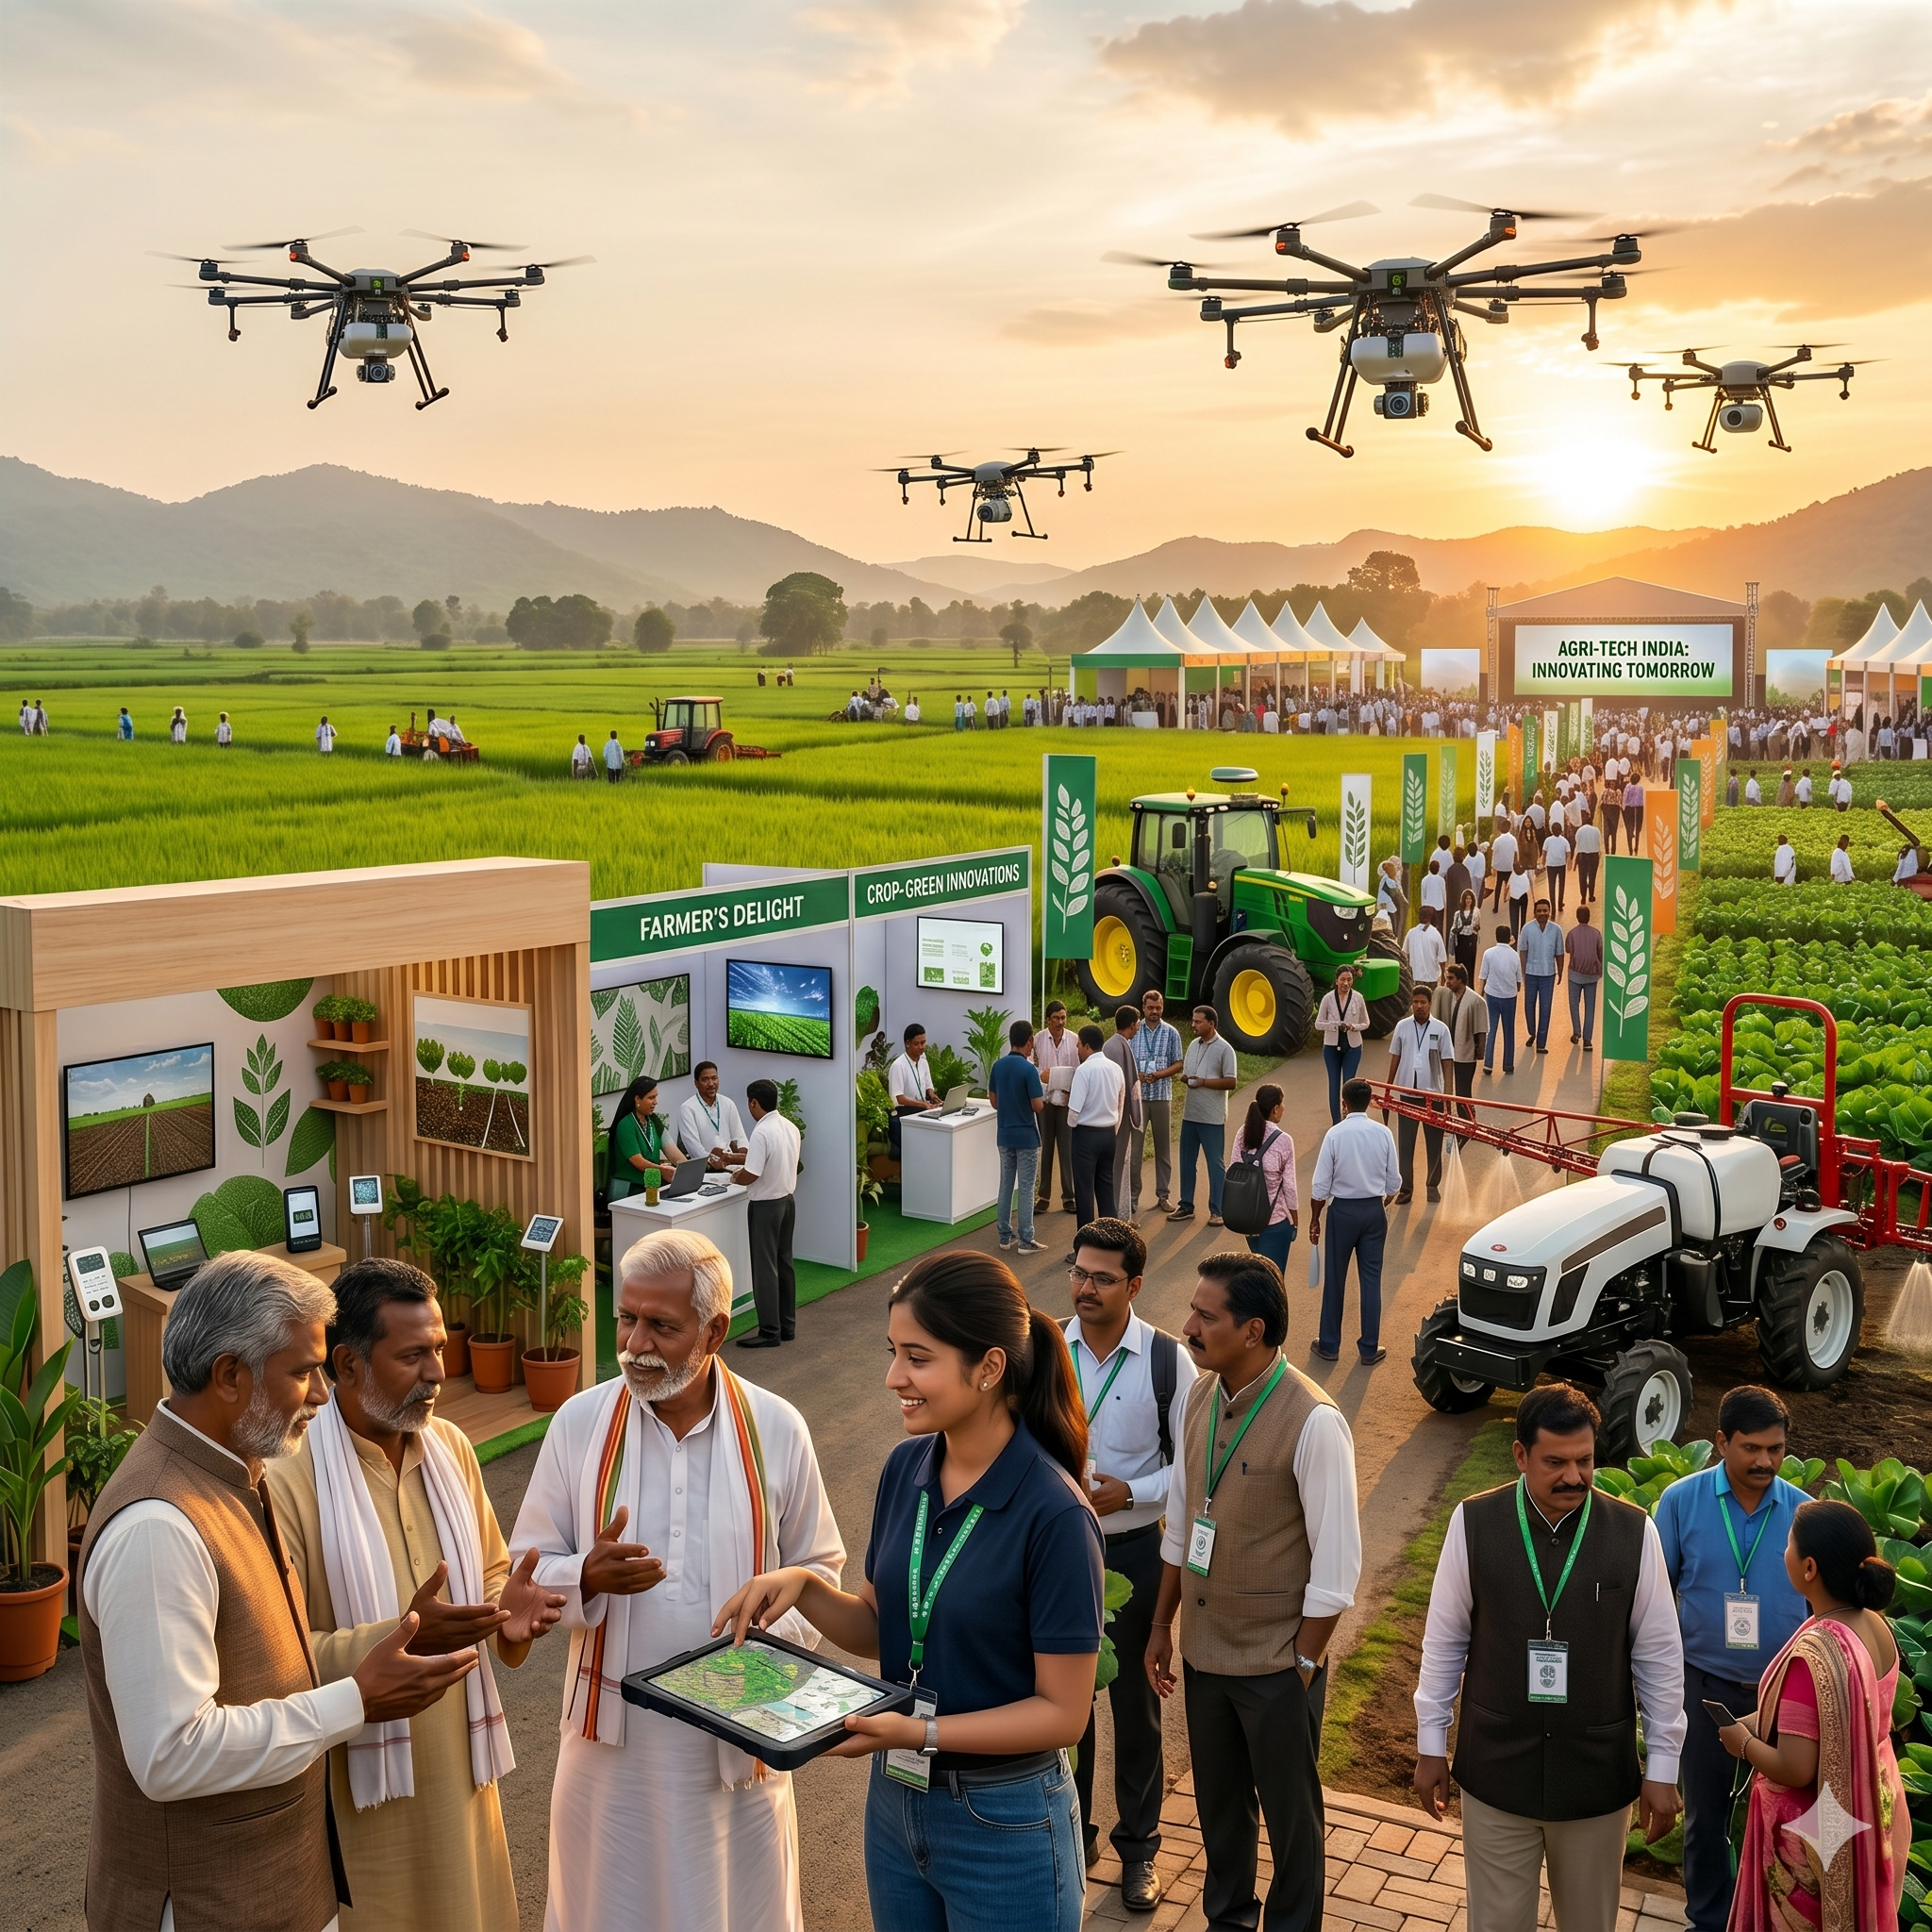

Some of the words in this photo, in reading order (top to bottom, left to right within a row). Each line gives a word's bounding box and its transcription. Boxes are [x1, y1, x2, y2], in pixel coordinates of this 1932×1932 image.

[1557, 641, 1638, 657] AGRI-TECH
[1642, 641, 1690, 657] INDIA:
[1532, 662, 1623, 678] INNOVATING
[1626, 662, 1715, 678] TOMORROW
[867, 874, 943, 905] CROP-GREEN
[946, 863, 1020, 892] INNOVATIONS
[640, 906, 729, 941] FARMER'S
[733, 895, 805, 926] DELIGHT
